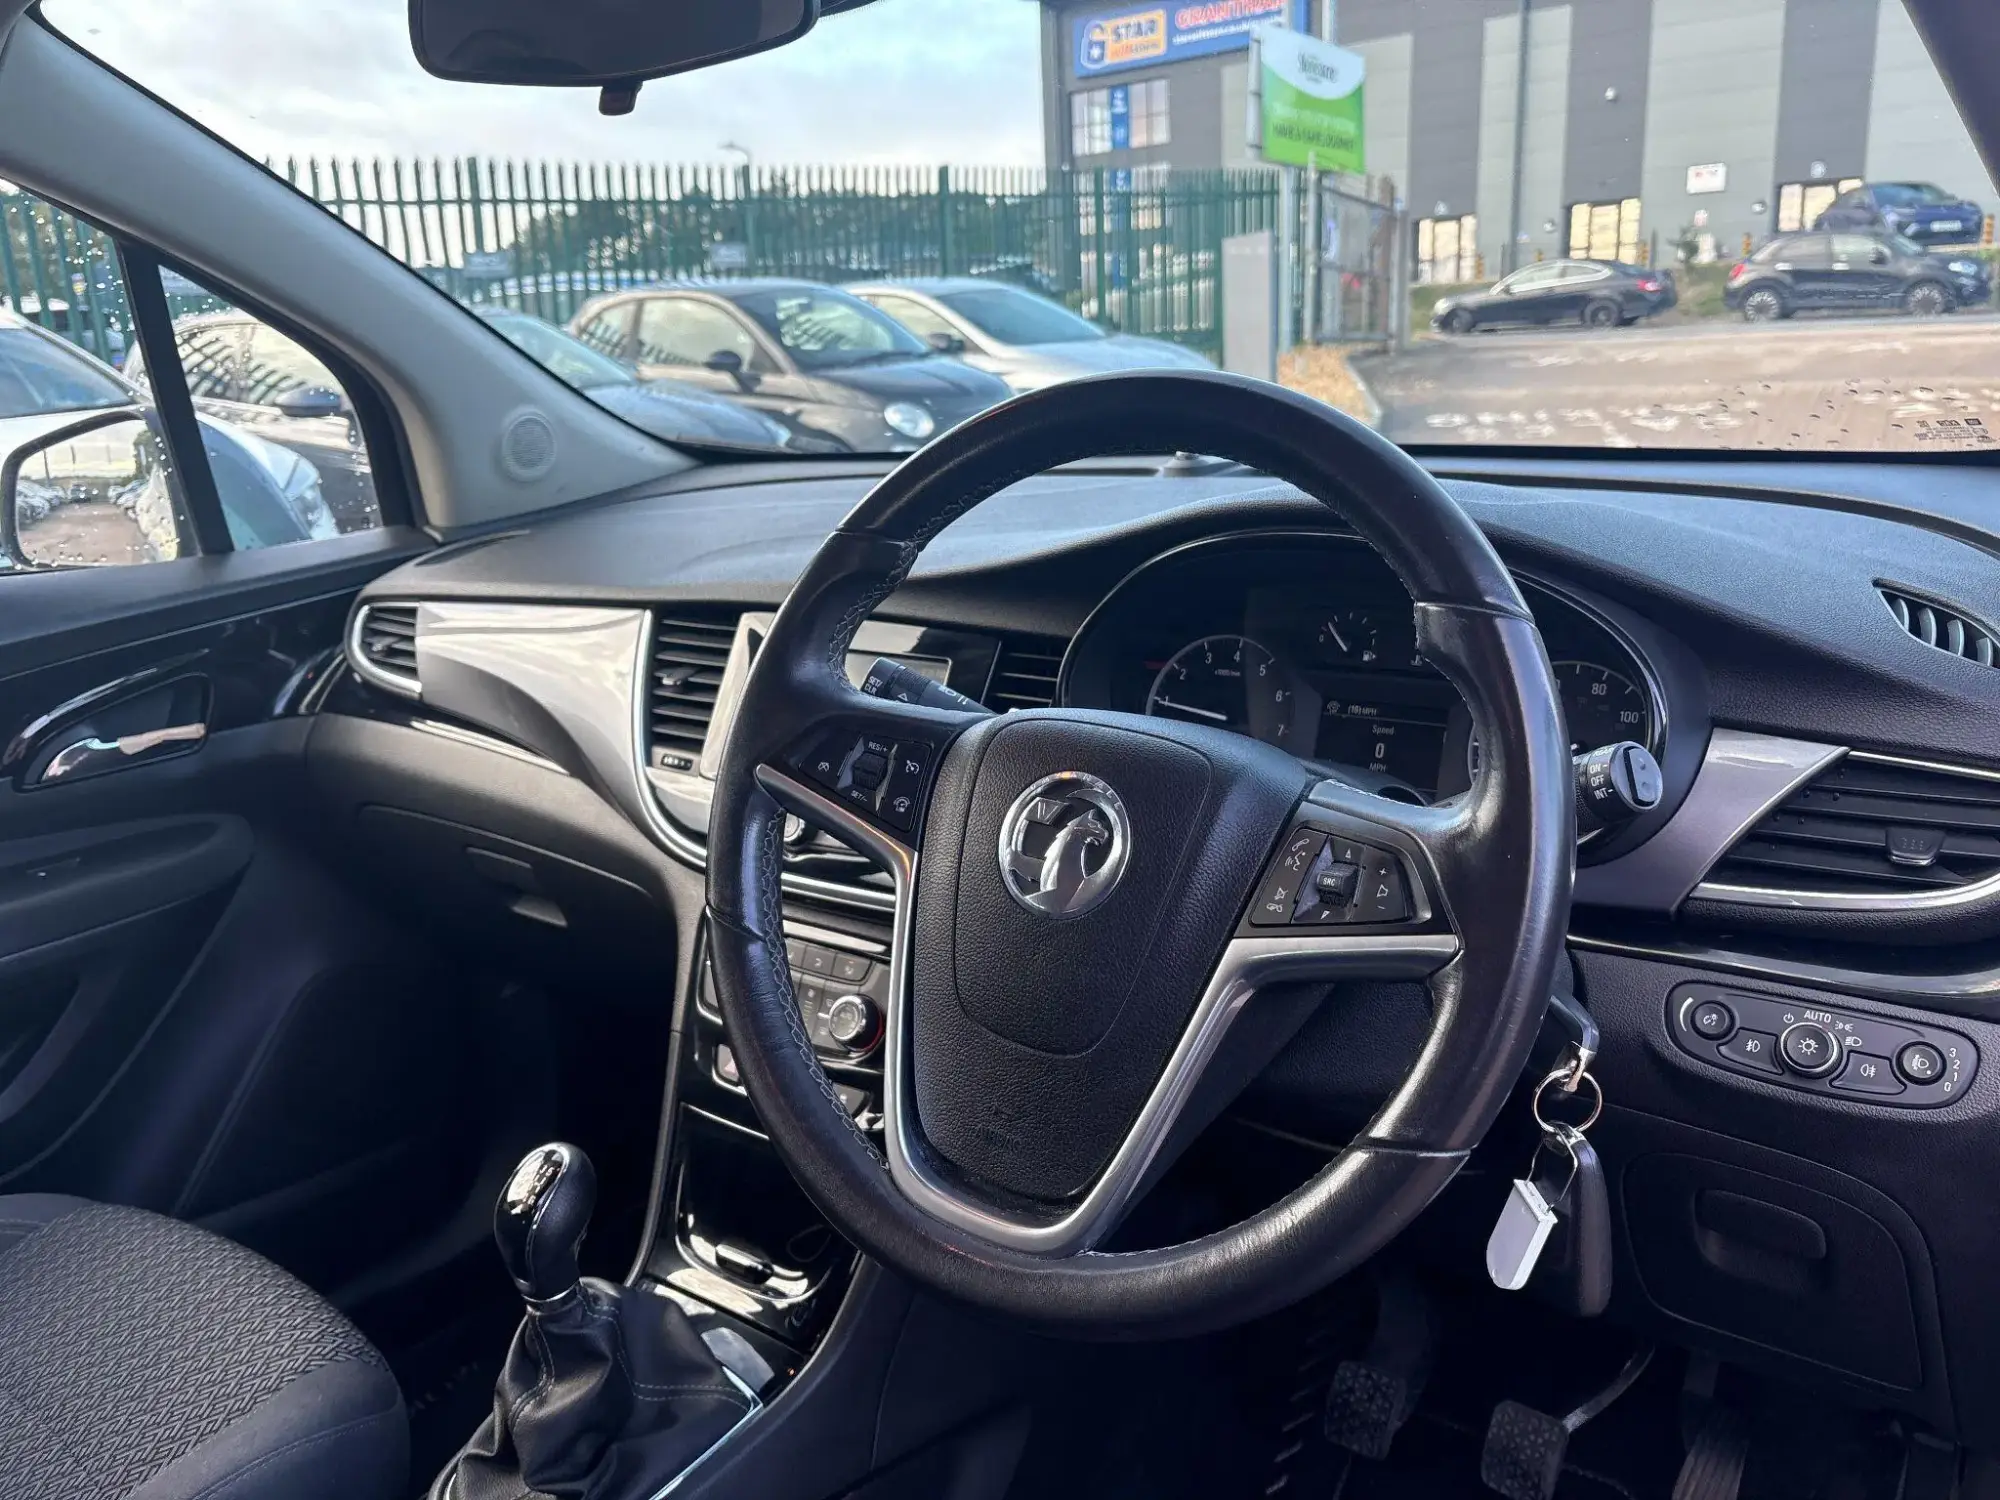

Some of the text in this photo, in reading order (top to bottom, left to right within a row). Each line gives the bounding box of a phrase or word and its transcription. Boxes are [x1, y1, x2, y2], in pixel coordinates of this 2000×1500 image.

[1205, 652, 1212, 664] 3
[1233, 650, 1241, 663] 4
[1179, 668, 1187, 680] 2
[1259, 664, 1266, 676] 5
[864, 684, 877, 695] CLR
[1275, 689, 1283, 702] 6
[1591, 683, 1607, 696] 80
[1619, 710, 1639, 724] 100
[1277, 724, 1285, 737] 7
[1372, 724, 1395, 736] Speed
[1374, 742, 1385, 759] 0
[1369, 762, 1387, 773] MPH
[1590, 763, 1601, 774] ON
[1590, 775, 1605, 787] OFF
[1322, 877, 1336, 886] SRC
[1803, 1009, 1832, 1024] AUTO
[1949, 1047, 1956, 1058] 3
[1953, 1059, 1961, 1070] 2
[1953, 1071, 1959, 1082] 1
[1944, 1082, 1951, 1092] 0
